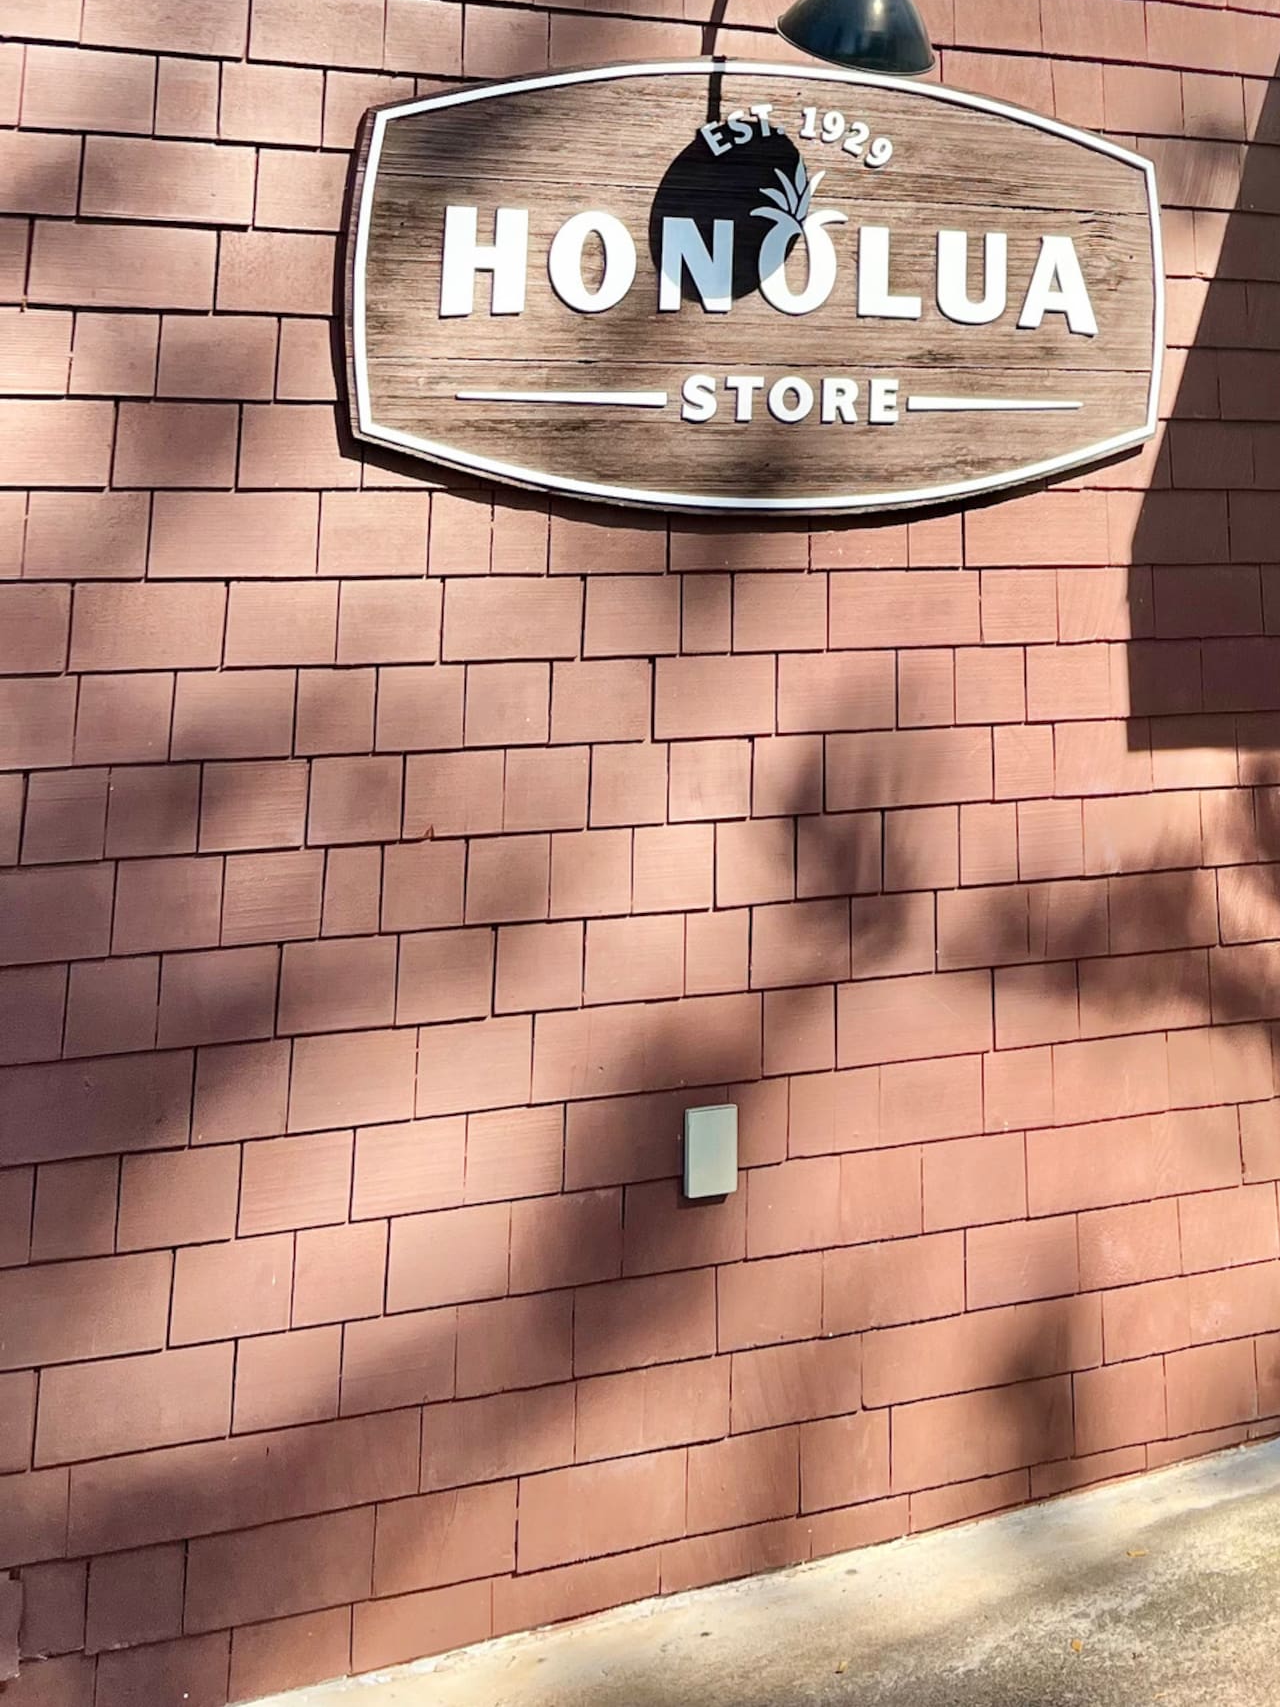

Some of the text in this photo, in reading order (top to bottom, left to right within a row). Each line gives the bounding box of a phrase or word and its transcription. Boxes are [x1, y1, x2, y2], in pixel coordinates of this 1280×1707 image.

[701, 104, 894, 167] EST. 1929
[438, 205, 1099, 336] HONOLUA
[681, 374, 900, 425] STORE
